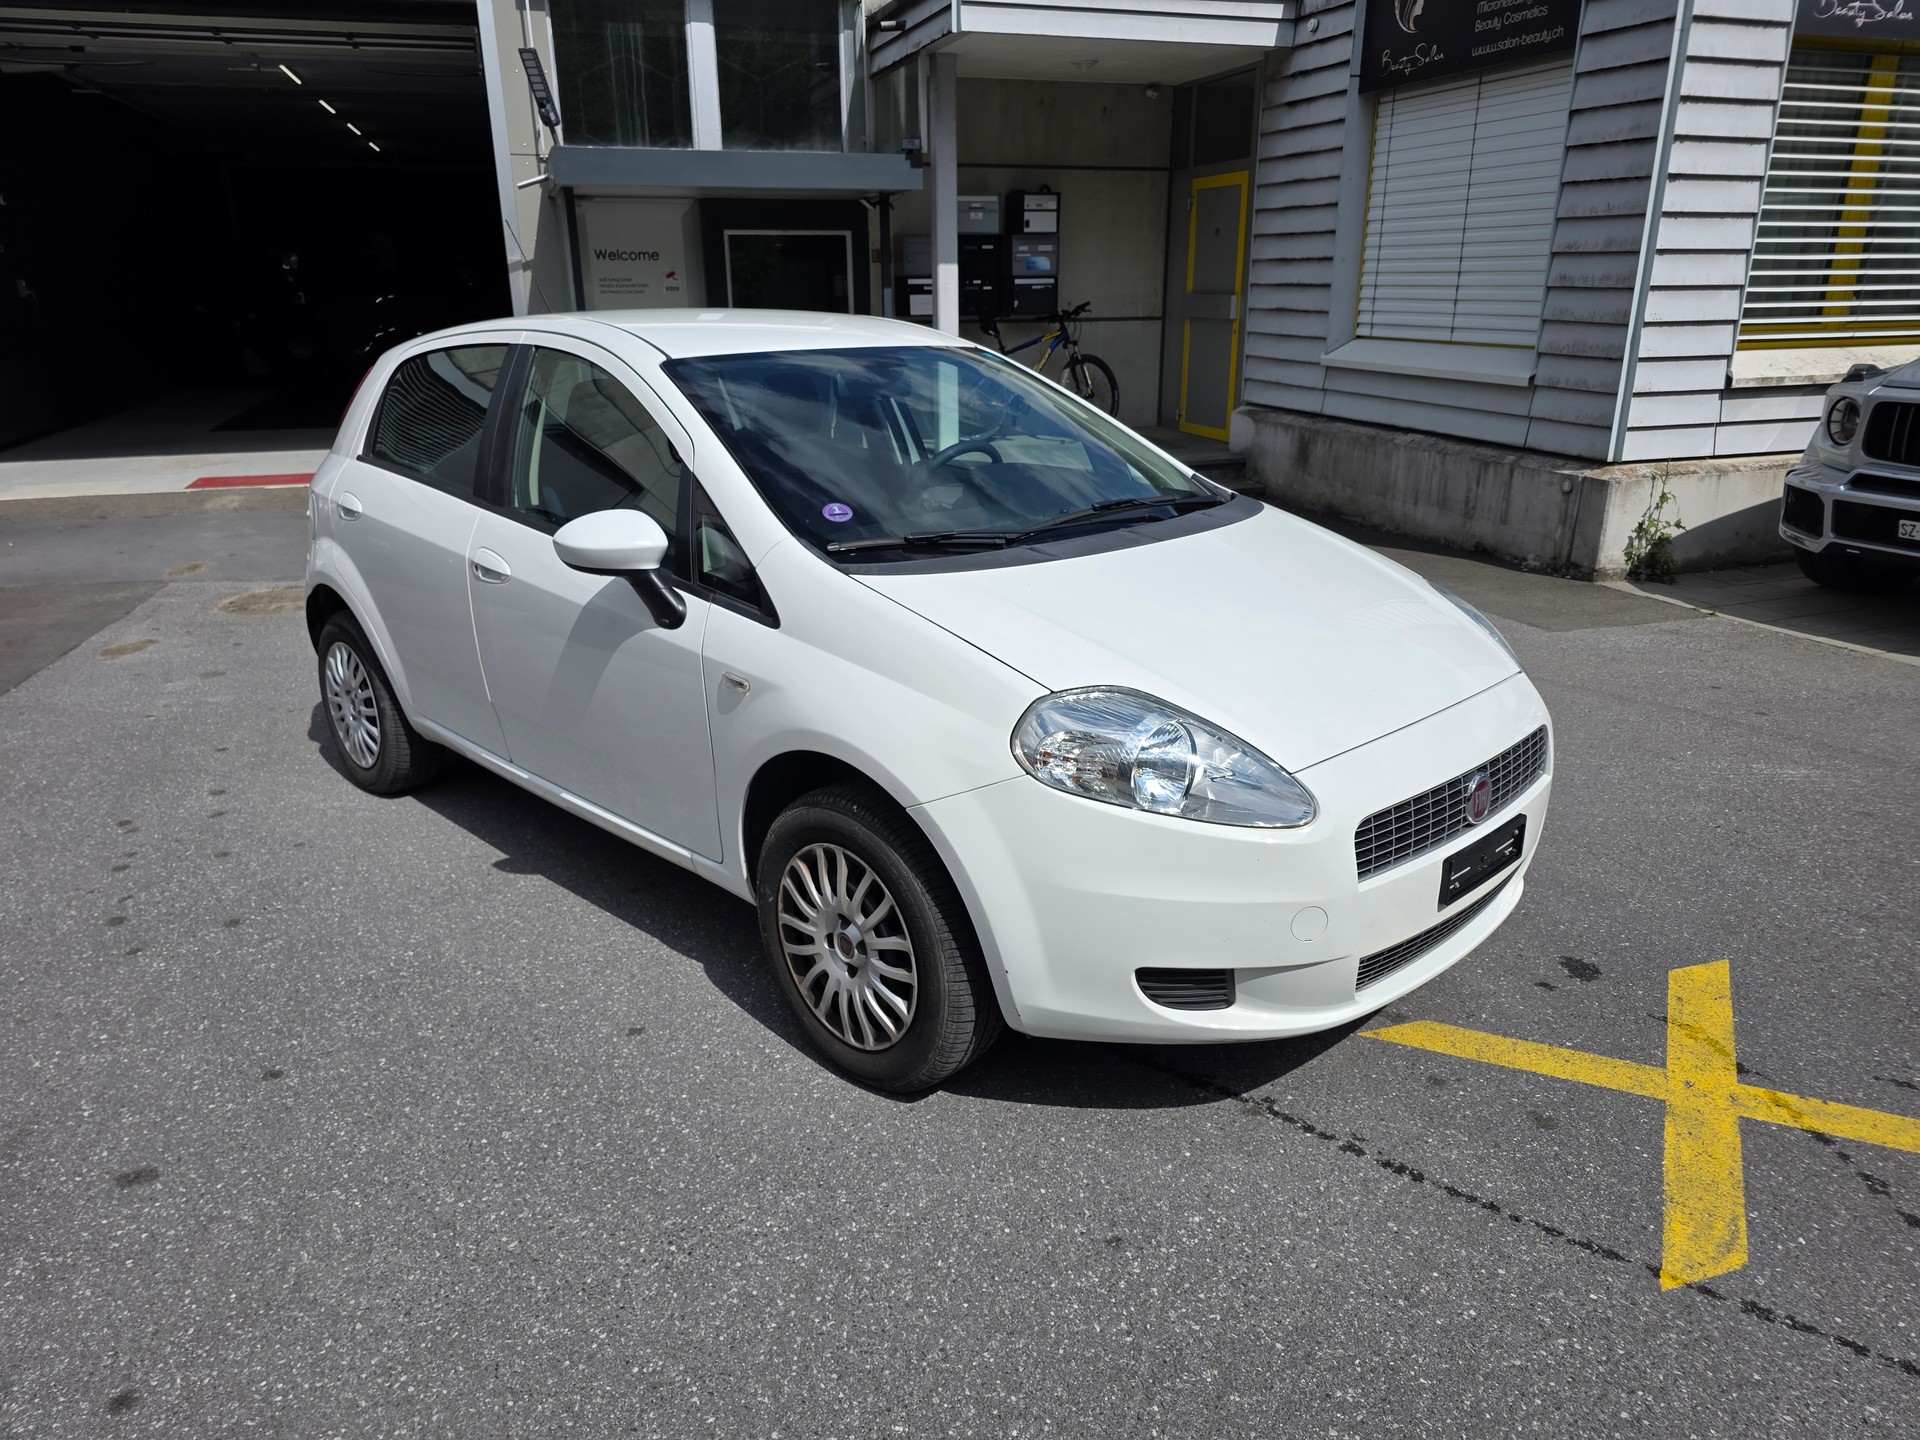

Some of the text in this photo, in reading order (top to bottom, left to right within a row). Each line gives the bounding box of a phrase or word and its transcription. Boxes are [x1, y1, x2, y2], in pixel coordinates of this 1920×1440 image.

[1475, 4, 1549, 33] Beauty Cosmetics
[1472, 26, 1564, 57] www.salon-beauty.ch
[1377, 43, 1445, 77] Beauty Salon
[594, 248, 660, 261] Welcome
[832, 506, 842, 514] 1
[1475, 787, 1489, 813] FIAT
